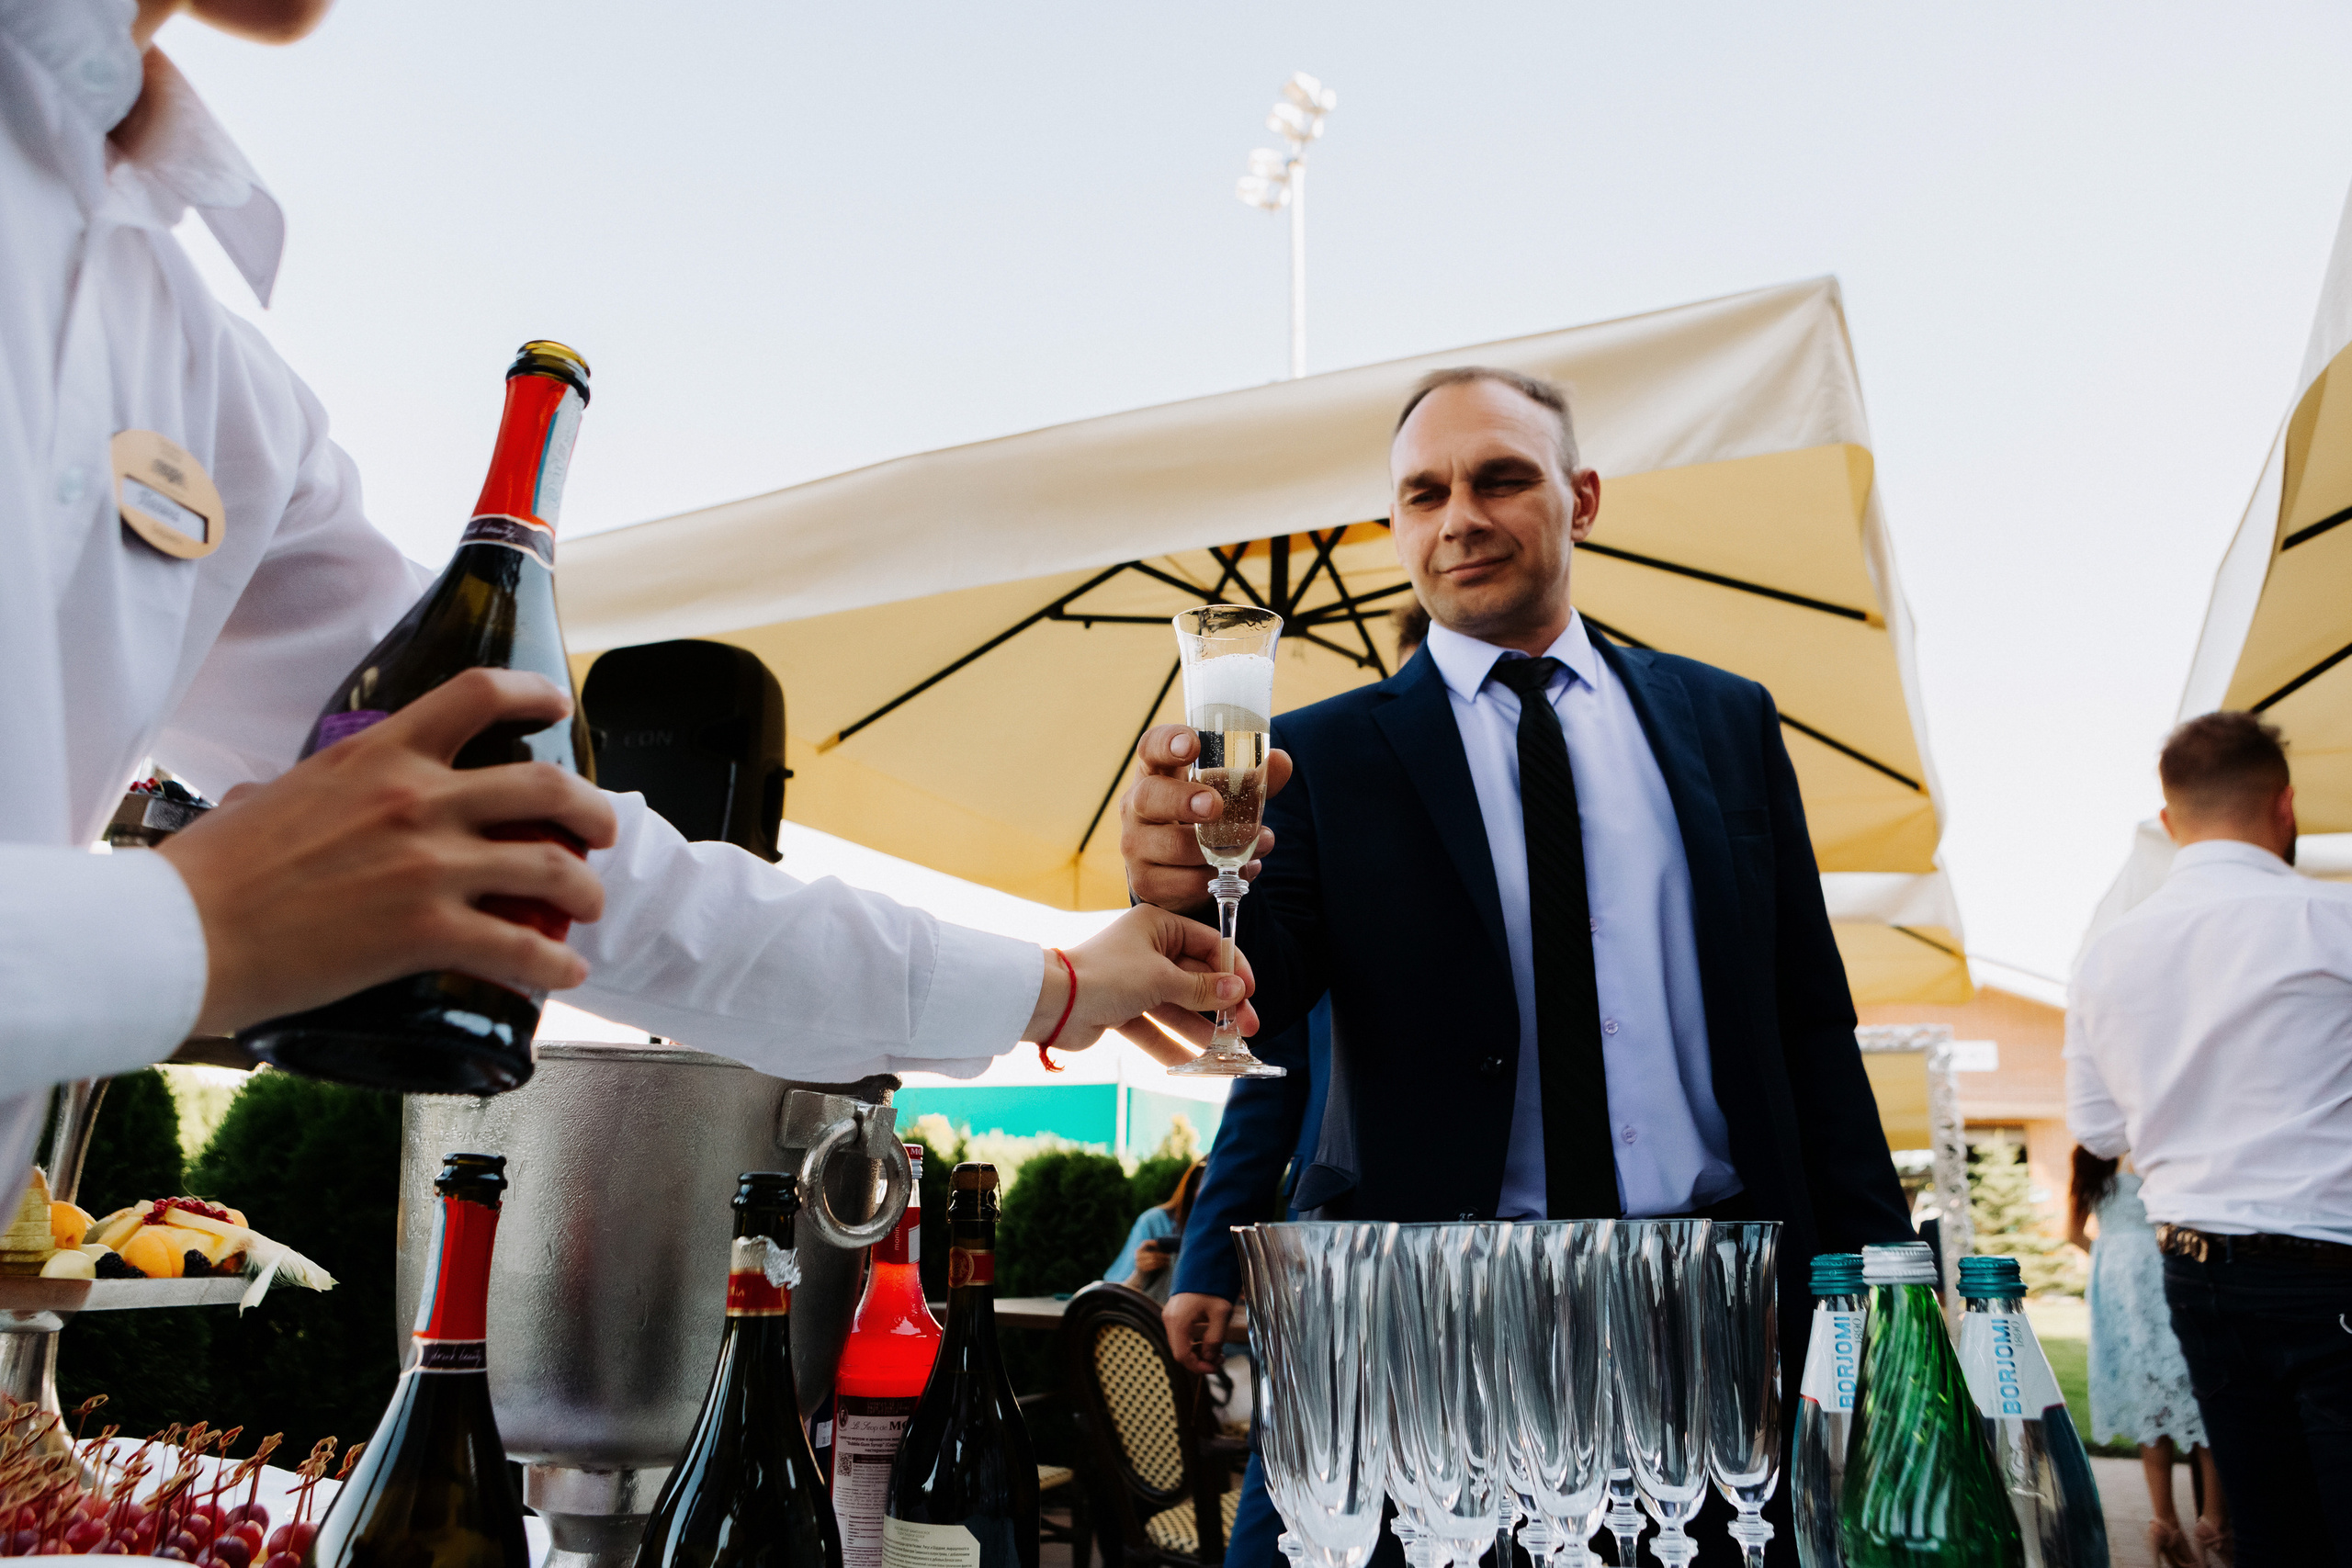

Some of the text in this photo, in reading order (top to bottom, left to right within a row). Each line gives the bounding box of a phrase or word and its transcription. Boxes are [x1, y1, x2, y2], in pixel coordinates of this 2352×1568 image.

[1853, 1318, 1863, 1343] 1890
[2011, 1321, 2024, 1347] 1890
[1834, 1316, 1856, 1408] BORJOMI
[1991, 1319, 2021, 1414] BORJOMI
